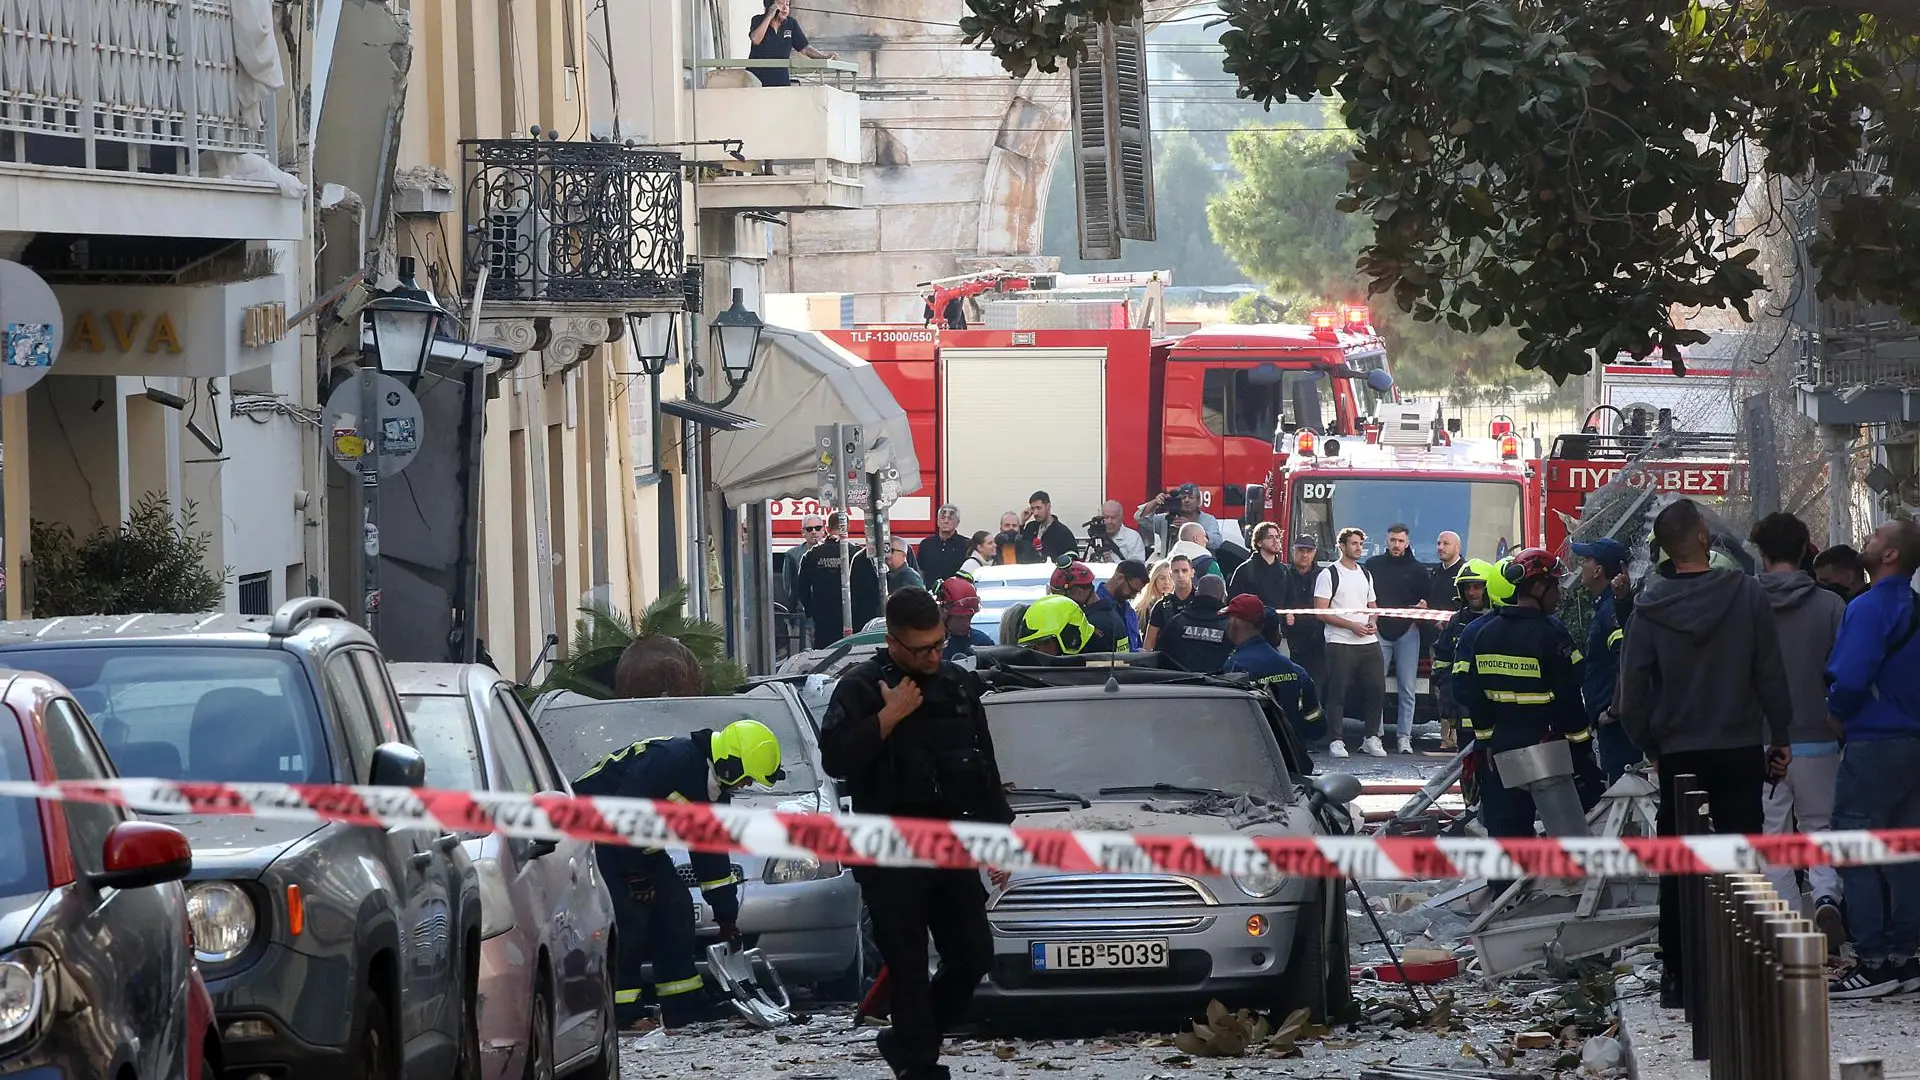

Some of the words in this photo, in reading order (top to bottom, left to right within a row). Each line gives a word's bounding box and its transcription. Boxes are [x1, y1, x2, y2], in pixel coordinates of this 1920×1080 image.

[850, 332, 932, 342] TLF-13000/550
[1303, 483, 1336, 499] B07
[1520, 663, 1539, 671] ΣΩΜΑ
